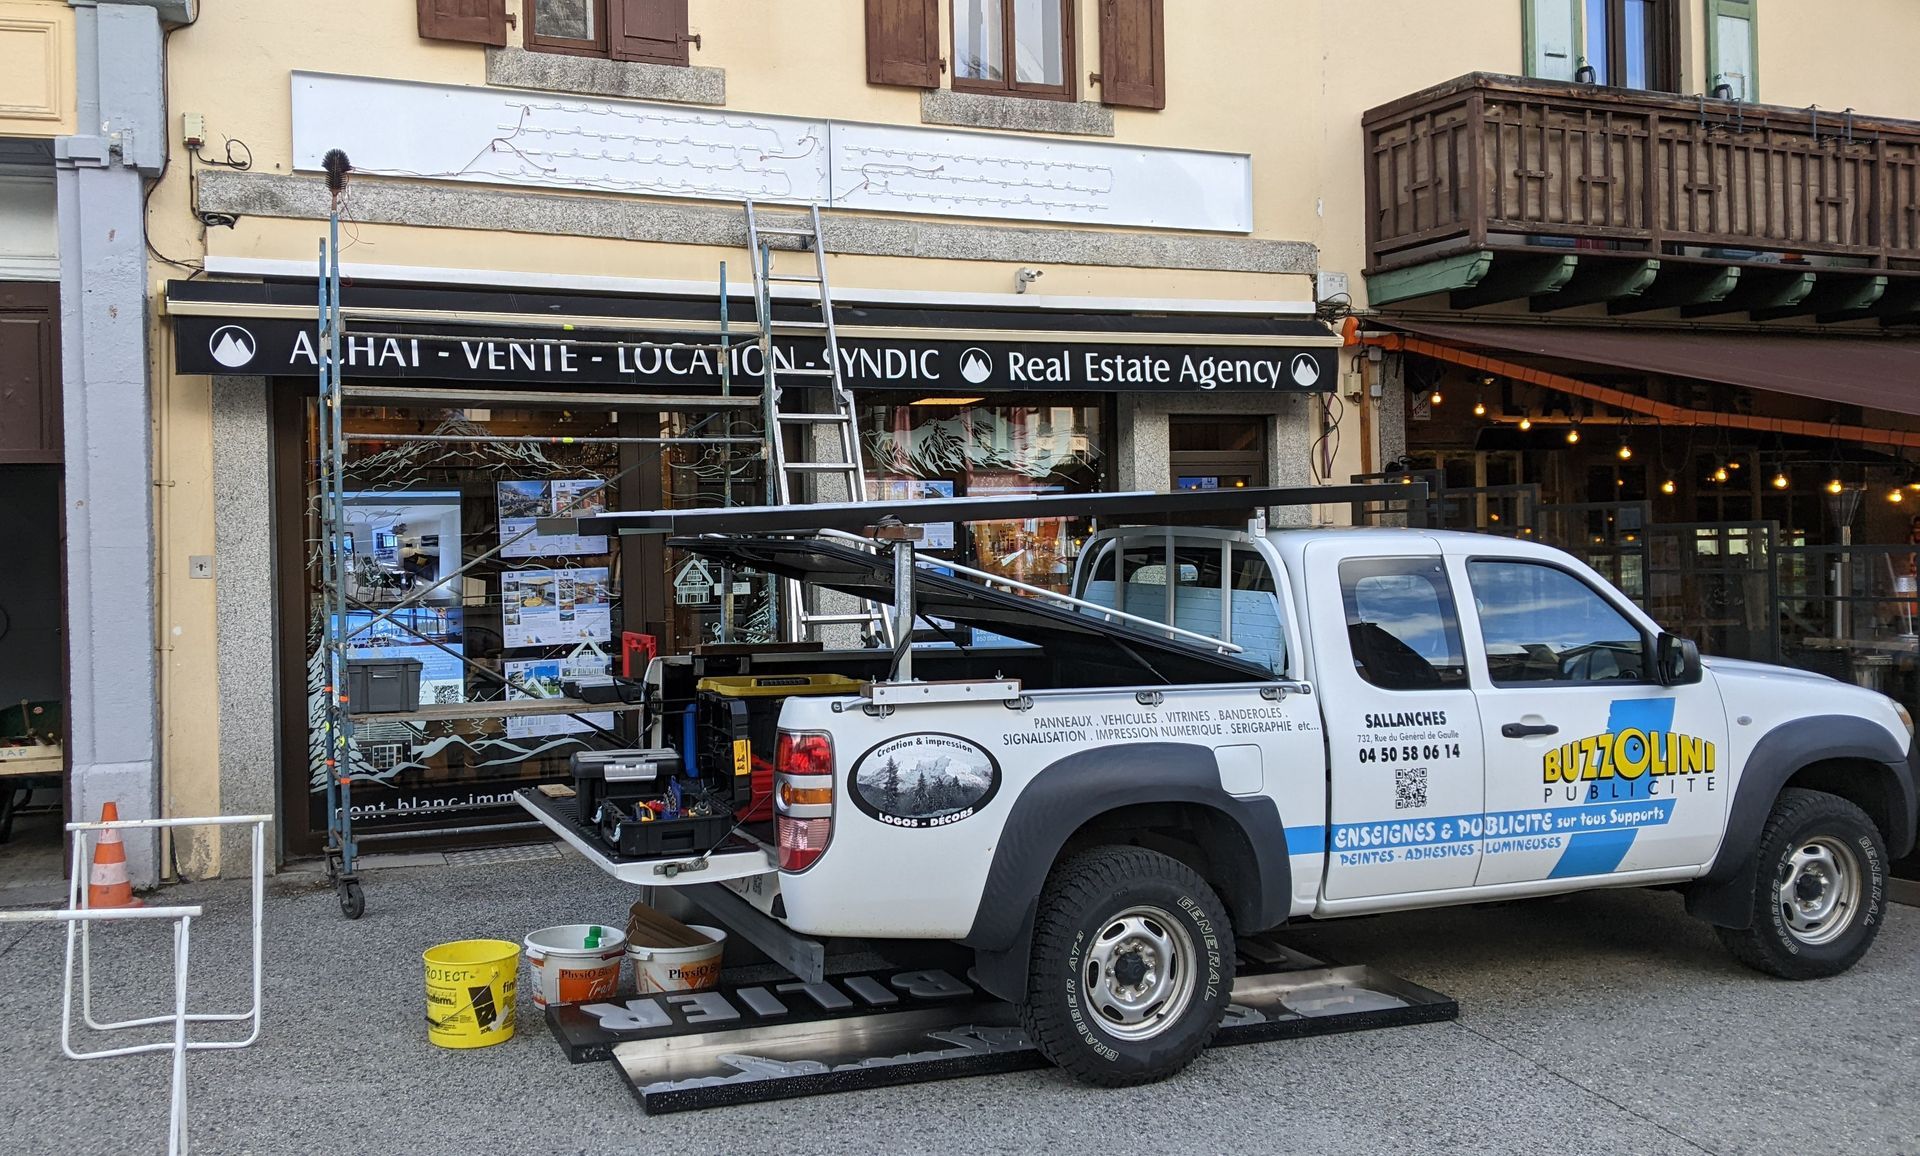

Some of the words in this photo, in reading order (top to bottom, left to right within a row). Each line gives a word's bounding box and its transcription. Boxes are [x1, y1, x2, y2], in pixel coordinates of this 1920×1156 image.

[289, 331, 420, 367] AHAT
[461, 338, 578, 372] VENTE
[1008, 350, 1071, 382] Real
[1085, 352, 1170, 383] Estate
[1179, 354, 1282, 390] Agency
[1033, 715, 1093, 729] PANNEAUX
[1100, 712, 1158, 726] VEHICULES
[1165, 710, 1211, 723] VITRINES
[1218, 707, 1283, 721] BANDEROLES
[1364, 711, 1447, 728] SALLANCHES
[915, 737, 923, 746] &
[925, 736, 973, 754] impression
[1002, 730, 1087, 746] SIGNALISATION
[1095, 726, 1159, 741] IMPRESSION
[1160, 724, 1223, 737] NUMERIQUE
[1230, 721, 1293, 735] SERIGRAPHIE
[1374, 733, 1387, 743] Rue
[1388, 732, 1398, 742] du
[1427, 730, 1436, 740] de
[1437, 729, 1459, 739] Gaulle
[1359, 747, 1376, 763] 04
[1381, 747, 1398, 762] 50
[1402, 745, 1419, 761] 58
[1423, 744, 1440, 760] 06
[1444, 743, 1461, 759] 14
[1543, 727, 1716, 784] BUZZOLINI
[1544, 776, 1716, 803] PUBLICITE
[878, 812, 918, 828] LOGOS
[930, 806, 974, 827] DÉCORS
[1335, 822, 1436, 848] ENSEIGNES
[1441, 823, 1453, 840] &
[1457, 813, 1553, 839] PUBLICITE
[1556, 817, 1576, 829] sur
[1580, 812, 1606, 826] tous
[1609, 806, 1664, 827] Supports
[1340, 850, 1395, 866] PEINTES
[1404, 843, 1474, 861] ADHESIVES
[1486, 837, 1562, 854] LUMINEUSES
[1858, 835, 1883, 927] GENERAL
[1176, 895, 1221, 1002] GENERAL
[1067, 977, 1120, 1062] GRABBER
